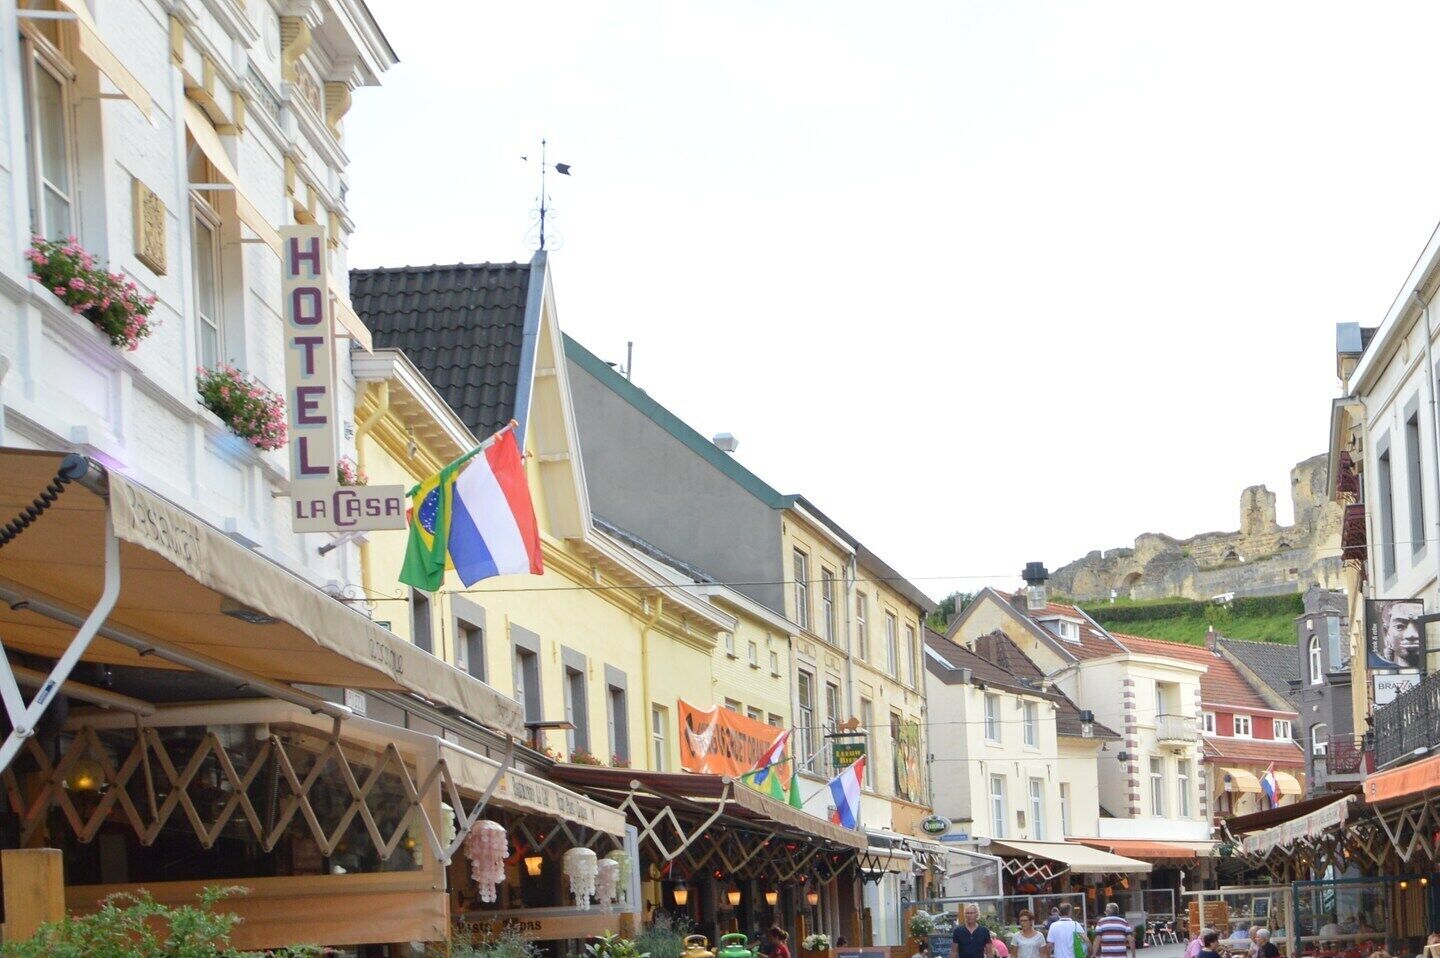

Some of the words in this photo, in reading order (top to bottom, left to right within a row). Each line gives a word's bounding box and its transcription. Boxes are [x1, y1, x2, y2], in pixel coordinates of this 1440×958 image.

[289, 237, 330, 475] HOTEL
[296, 500, 326, 519] LA
[333, 490, 401, 526] CASA
[1378, 679, 1414, 692] BRAZZA
[503, 918, 542, 932] Tpas
